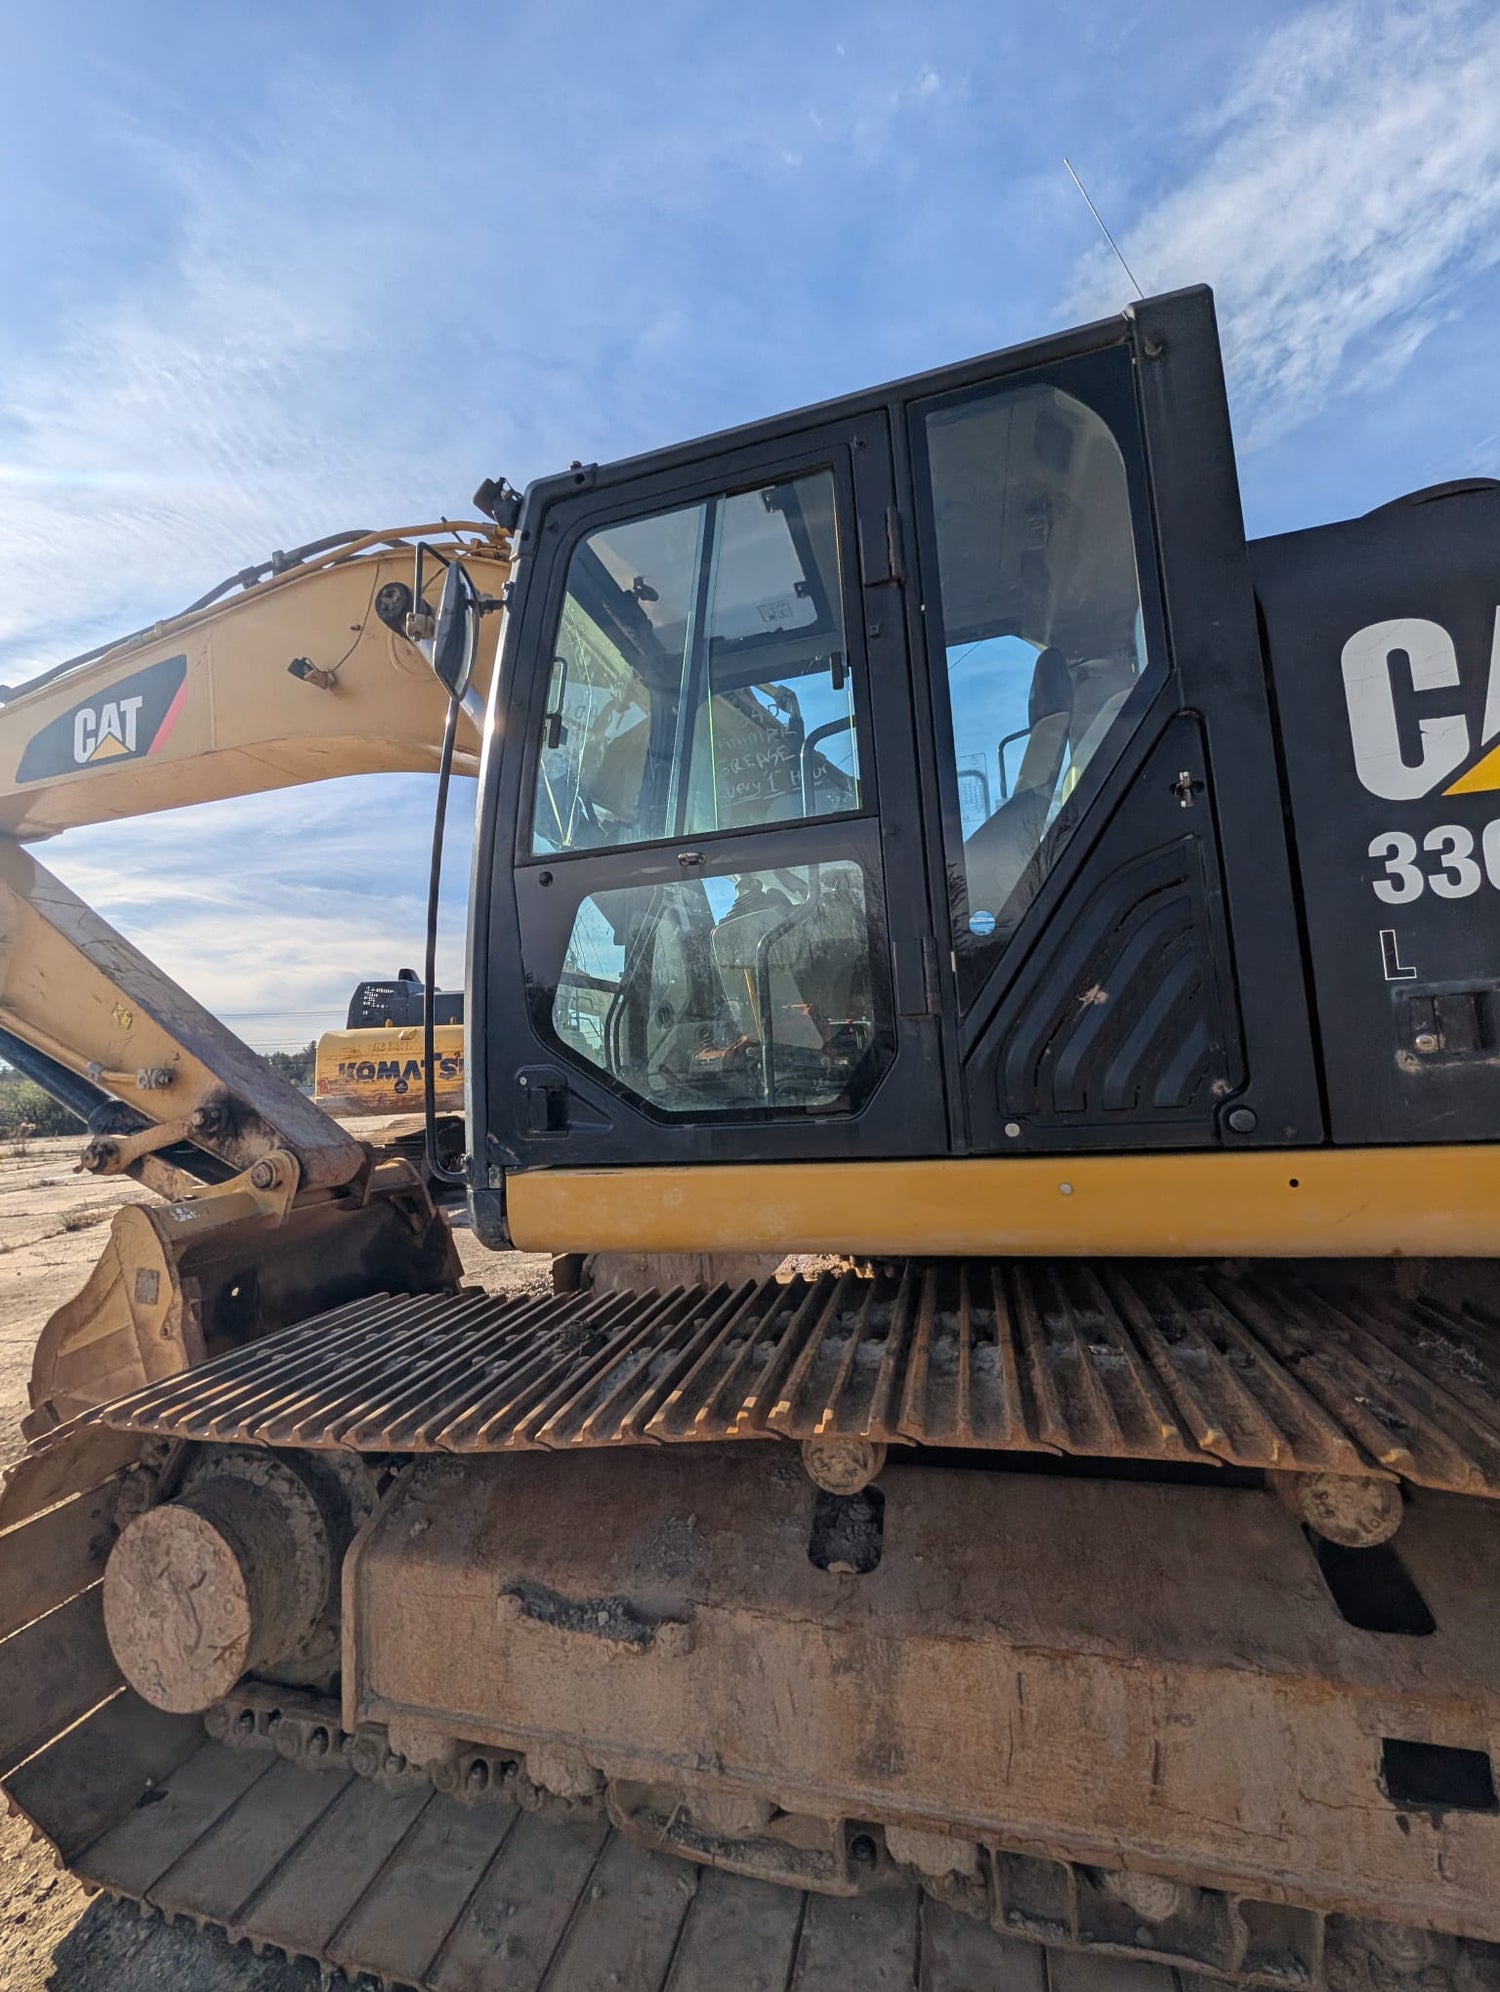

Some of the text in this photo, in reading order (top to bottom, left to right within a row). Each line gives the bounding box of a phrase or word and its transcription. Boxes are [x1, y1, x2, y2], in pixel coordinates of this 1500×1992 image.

[73, 695, 143, 764] CAT
[1341, 605, 1500, 801] C
[790, 763, 829, 787] Hur
[1378, 929, 1417, 982] L
